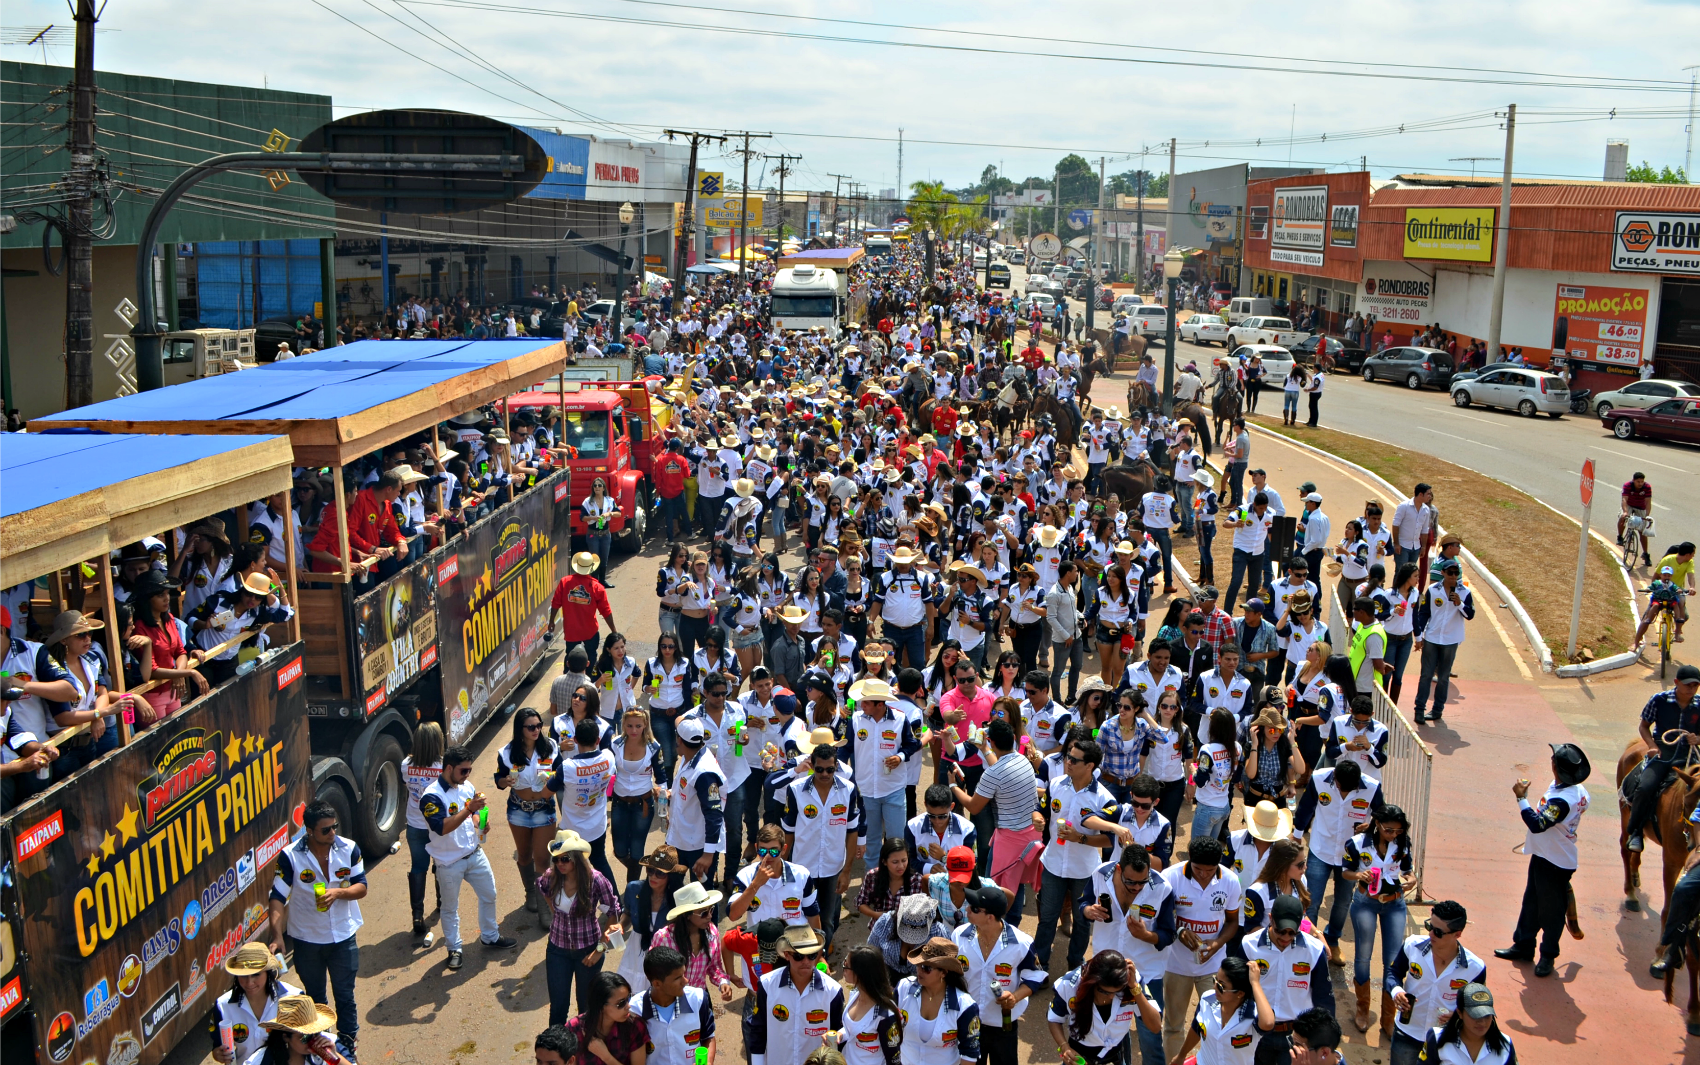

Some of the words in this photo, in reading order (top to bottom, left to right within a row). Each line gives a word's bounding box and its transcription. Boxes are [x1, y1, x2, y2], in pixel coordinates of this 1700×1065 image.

[1286, 195, 1325, 223] RONDOBRAS
[1407, 216, 1481, 243] Continental
[1619, 257, 1661, 268] PEÇAS,
[1665, 259, 1700, 268] PNEU
[1378, 279, 1430, 297] RONDOBRAS
[1370, 305, 1381, 314] TEL:
[1382, 307, 1420, 320] 3211-2600
[1396, 298, 1409, 306] AUTO
[1558, 292, 1645, 316] PROMOÇÃO
[1607, 324, 1639, 337] 46,00
[1605, 347, 1636, 359] 38,50
[1581, 473, 1593, 492] PARE
[494, 537, 527, 588] prime
[462, 575, 526, 674] COMITIVA
[526, 544, 558, 616] PRIME
[391, 630, 414, 669] VILA
[279, 663, 301, 687] ITAIPAVA
[386, 650, 419, 695] COUNTRY
[157, 736, 204, 775] COMITIVA
[408, 768, 440, 777] ITAIPAVA
[578, 763, 608, 776] ITAIPAVA
[146, 750, 217, 829] prime
[19, 819, 61, 857] ITAIPAVA
[73, 799, 214, 959] COMITIVA
[216, 740, 286, 846] PRIME
[268, 832, 288, 858] DINIZ
[202, 867, 235, 910] ARGO
[1178, 920, 1217, 933] ITAIPAVA
[206, 924, 243, 973] dydyo
[152, 992, 178, 1025] CONTROL
